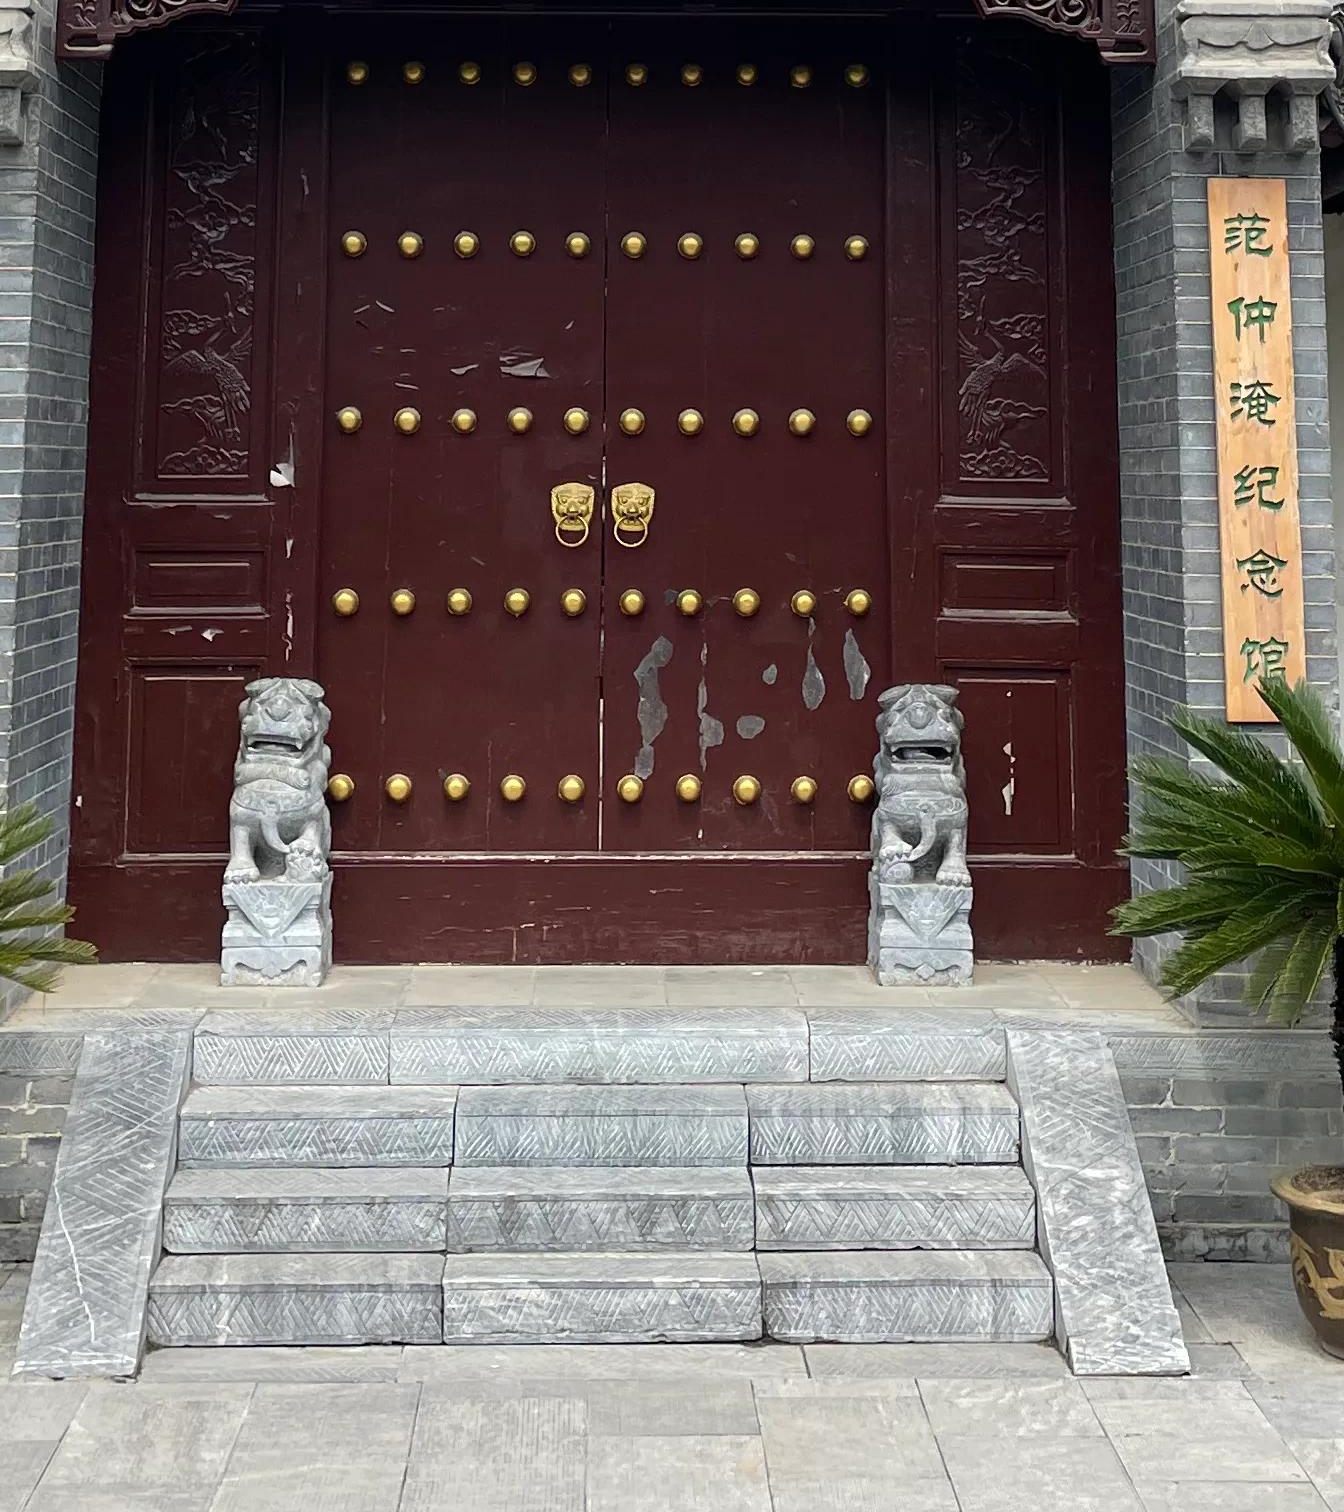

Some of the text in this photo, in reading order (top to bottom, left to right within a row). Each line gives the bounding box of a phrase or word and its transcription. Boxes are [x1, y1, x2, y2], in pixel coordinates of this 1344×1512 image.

[1224, 212, 1289, 683] 范仲淹纪念馆
